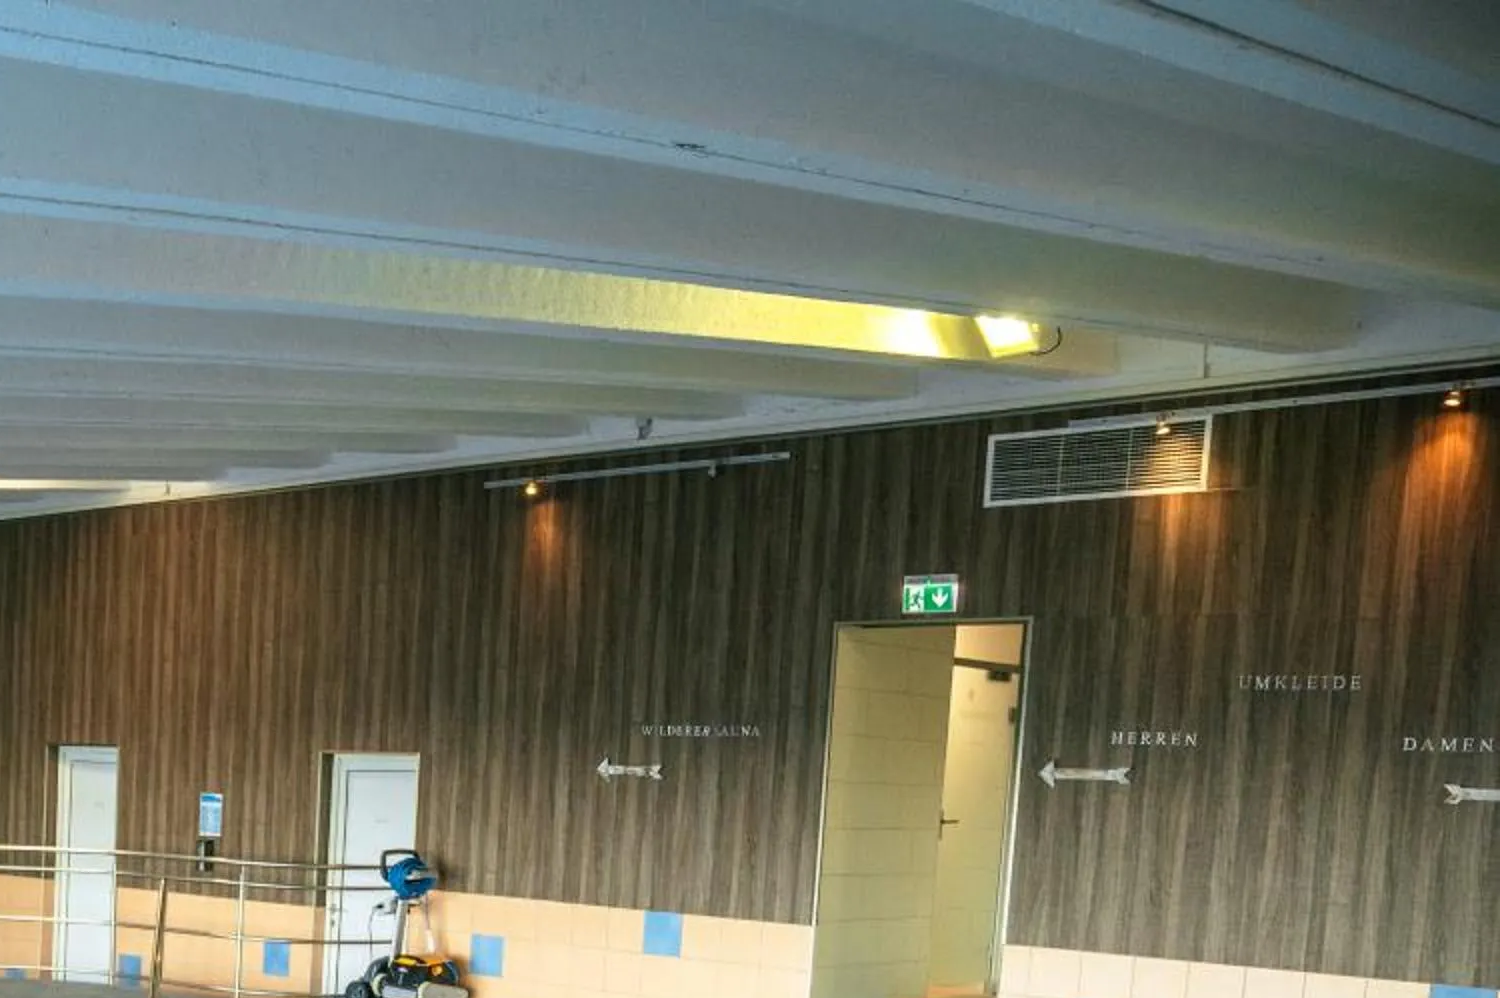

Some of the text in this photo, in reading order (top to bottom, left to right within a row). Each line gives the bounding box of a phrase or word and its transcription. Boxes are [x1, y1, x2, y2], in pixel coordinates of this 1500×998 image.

[1237, 675, 1361, 689] UMKLEIDE
[1110, 731, 1198, 746] HERREN
[1403, 737, 1494, 752] DAMEN
